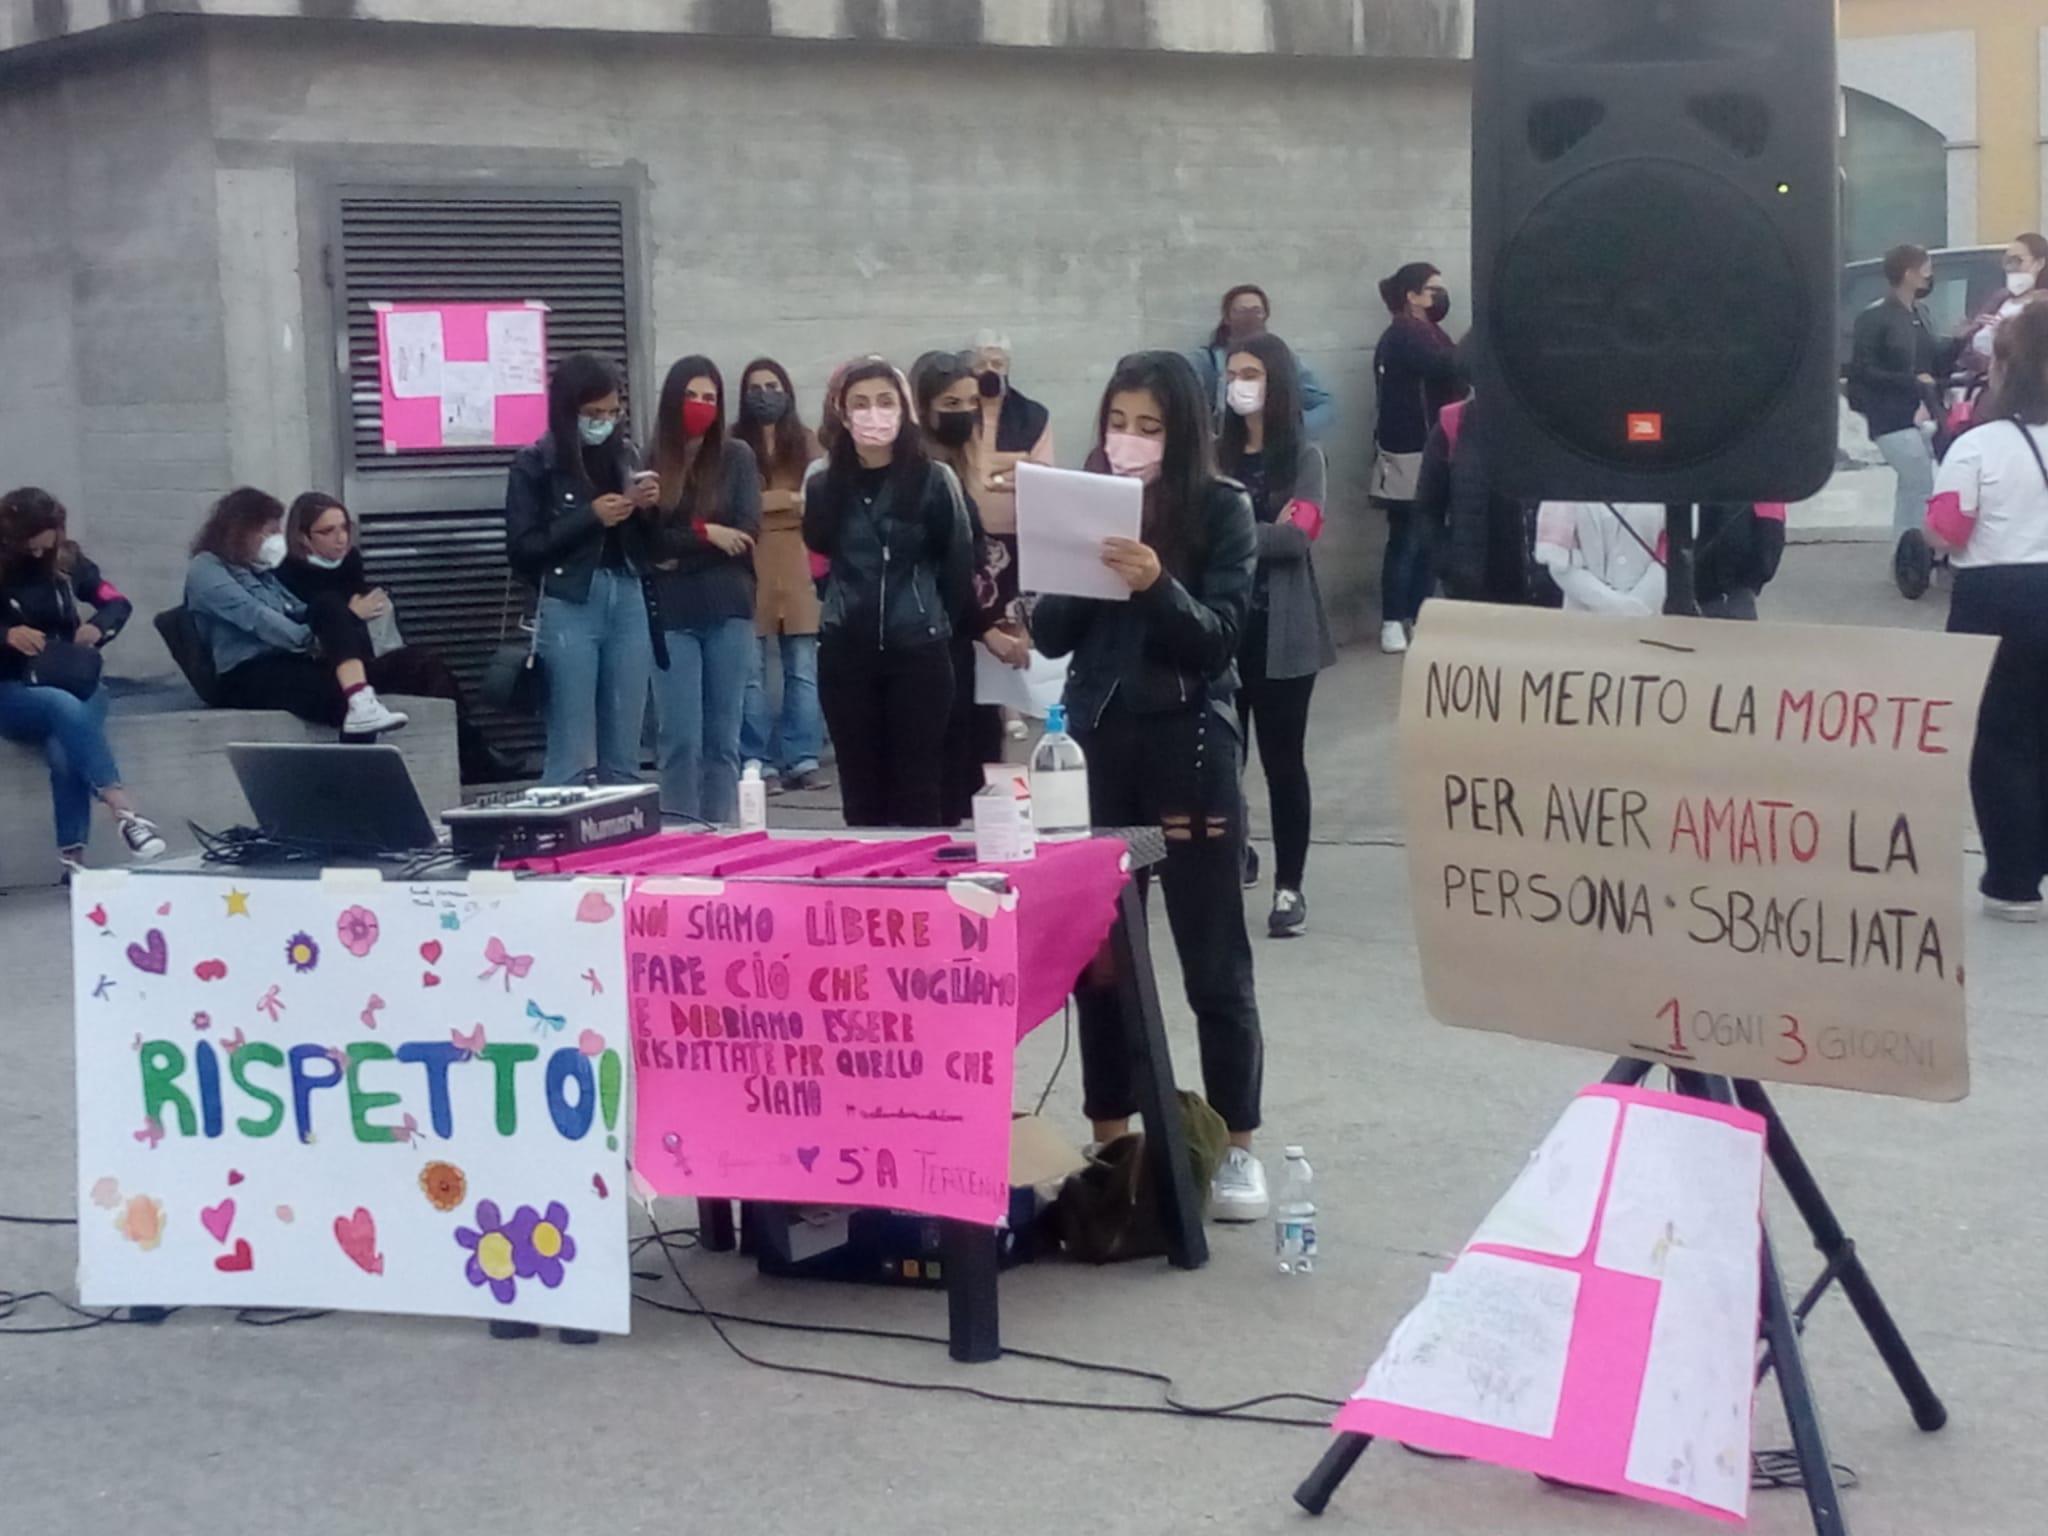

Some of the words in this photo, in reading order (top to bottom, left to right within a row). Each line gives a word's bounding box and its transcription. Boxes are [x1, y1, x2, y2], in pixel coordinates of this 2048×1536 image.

[1426, 661, 1501, 722] NON
[1520, 669, 1687, 727] MERITO
[1710, 683, 1756, 735] LA
[1775, 689, 1952, 754] MORTE
[1445, 774, 1524, 837] PER
[1544, 783, 1651, 849] AVER
[1670, 797, 1820, 864] AMATO
[1848, 810, 1919, 874] LA
[630, 900, 668, 937] NOI
[686, 901, 773, 942] SIAMO
[806, 900, 930, 947] LIBERE
[959, 913, 989, 952] DI
[1445, 864, 1653, 937] PERSONA
[632, 952, 706, 995] FARE
[809, 964, 870, 1002] CHE
[670, 1001, 803, 1040] DOBBIAMO
[822, 1008, 915, 1043] ESSERE
[1656, 997, 1687, 1052] 1
[1692, 1009, 1764, 1047] OGNI
[1776, 1014, 1808, 1065] 3
[1817, 1025, 1936, 1069] GIORNI
[636, 1038, 777, 1075] RISPETTATE
[784, 1043, 825, 1076] PER
[836, 1048, 924, 1078] QUELLO
[945, 1051, 994, 1085] CHE
[138, 1038, 622, 1153] RISPETTO!
[743, 1075, 823, 1117] SIAMO
